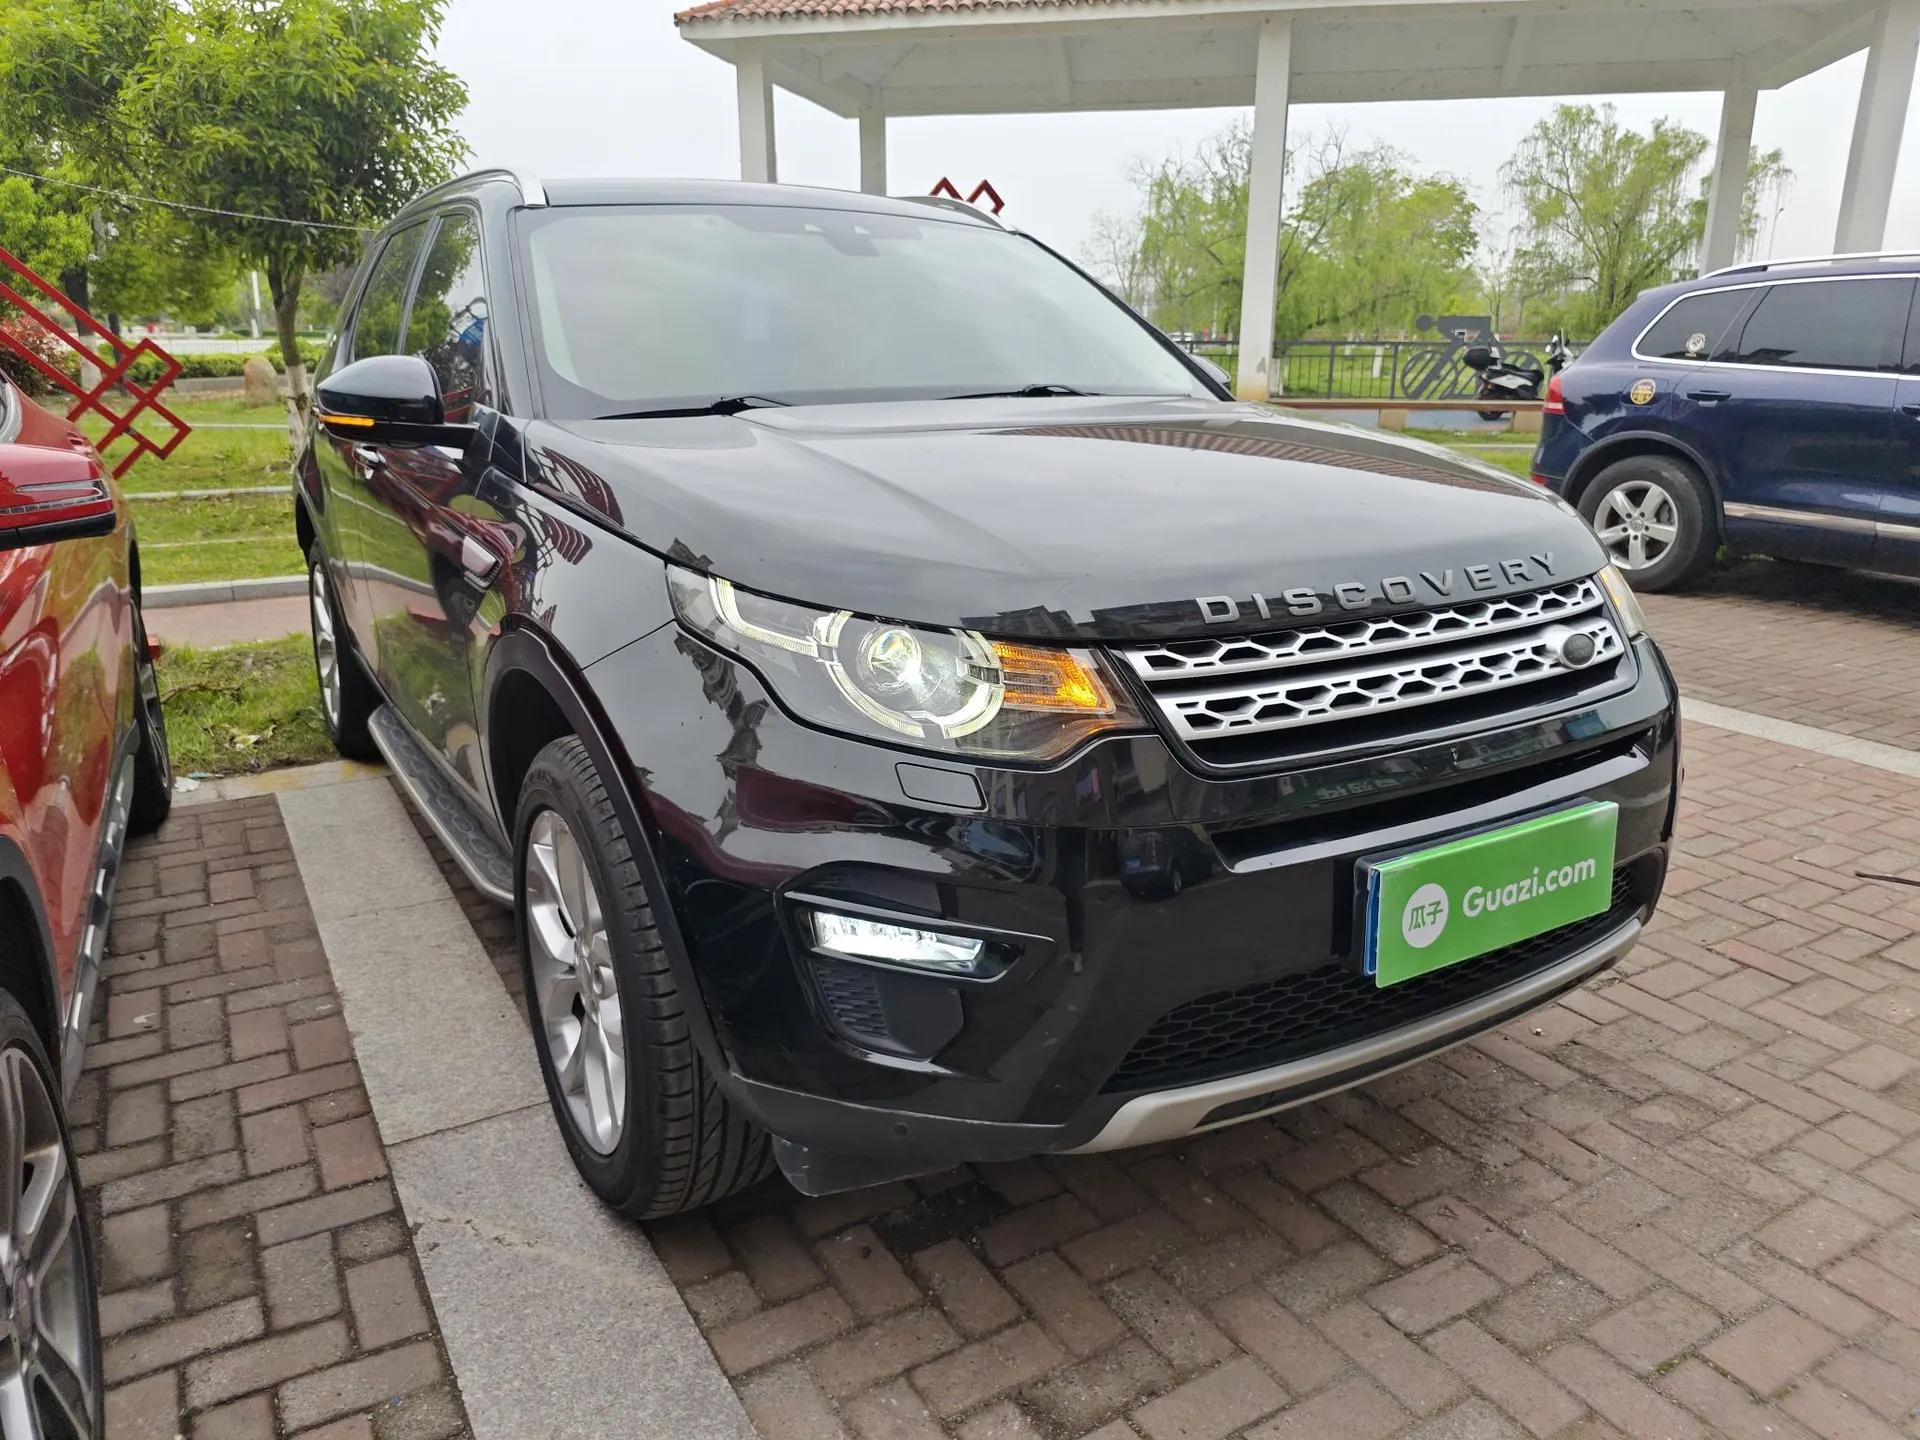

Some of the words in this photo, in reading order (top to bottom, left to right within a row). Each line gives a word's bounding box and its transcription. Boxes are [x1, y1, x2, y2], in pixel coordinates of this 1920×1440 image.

[1195, 551, 1557, 624] DISCOVERY
[1408, 900, 1443, 931] 瓜子
[1463, 858, 1596, 917] Guazi.com
